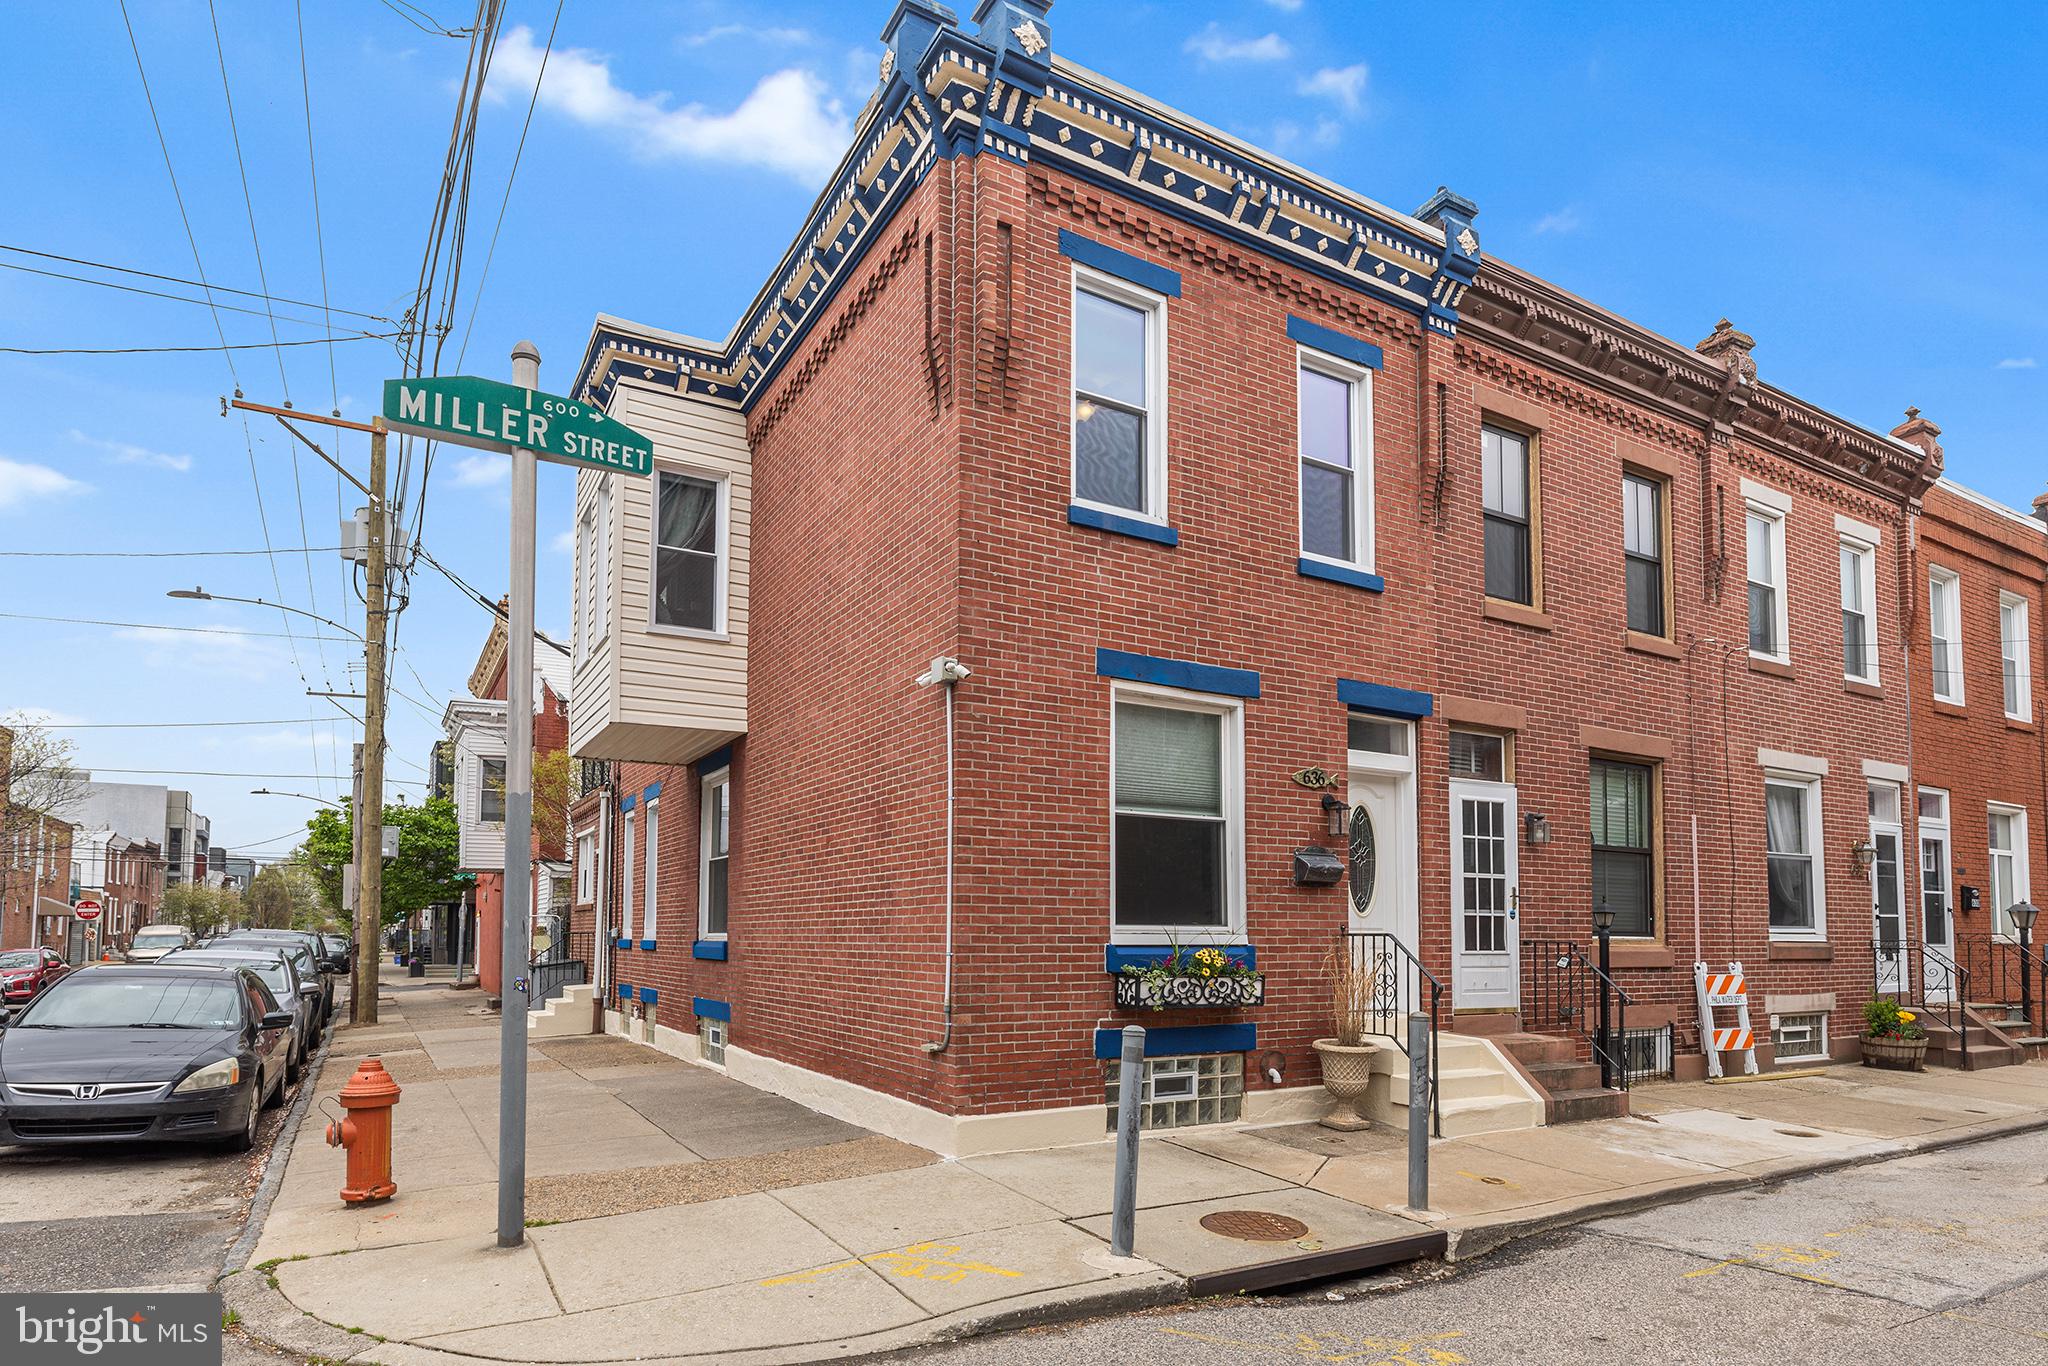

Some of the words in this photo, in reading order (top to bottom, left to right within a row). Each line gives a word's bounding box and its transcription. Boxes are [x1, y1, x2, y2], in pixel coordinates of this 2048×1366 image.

[542, 400, 579, 418] 600
[399, 386, 550, 448] MILLER
[563, 431, 647, 470] STREET
[1303, 770, 1325, 786] 636
